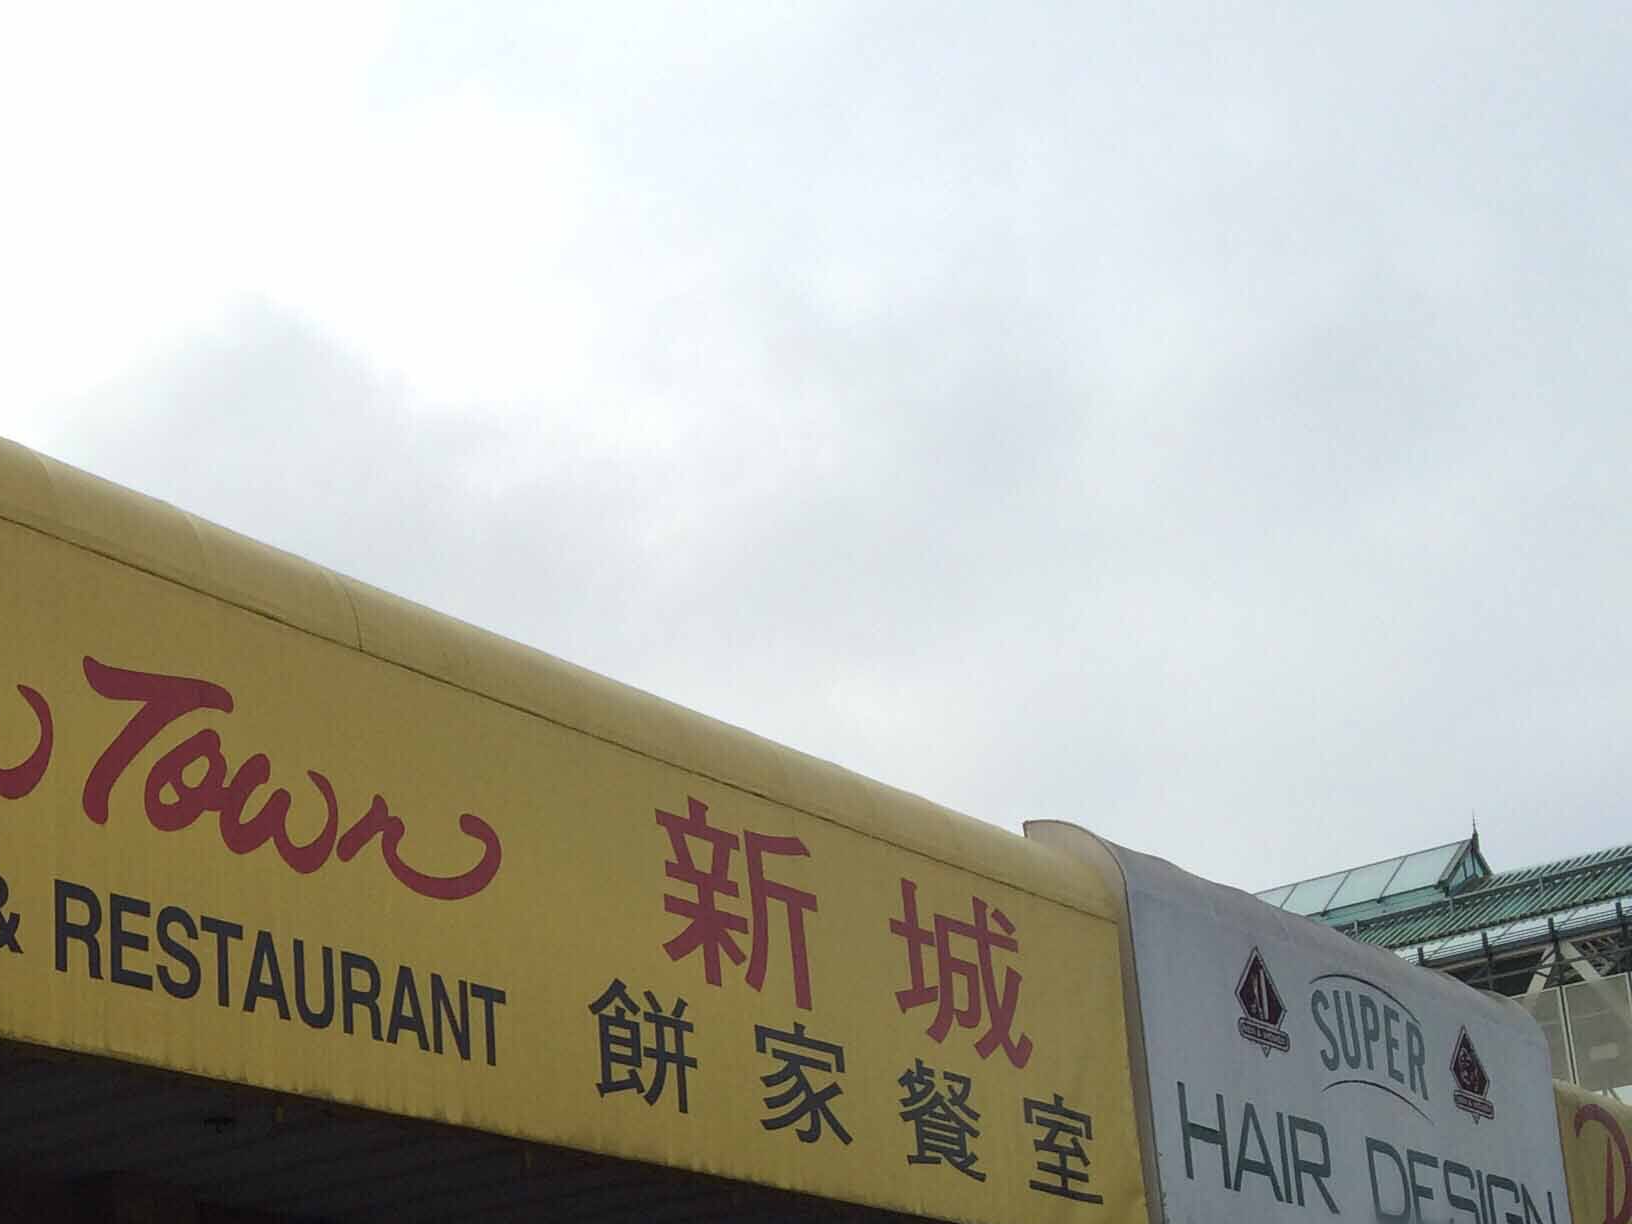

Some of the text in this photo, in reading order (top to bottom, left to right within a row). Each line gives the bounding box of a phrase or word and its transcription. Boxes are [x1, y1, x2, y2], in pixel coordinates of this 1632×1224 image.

[81, 655, 502, 900] Town
[53, 879, 507, 1067] RESTAURANT
[1310, 988, 1431, 1102] SUPER
[1176, 1081, 1341, 1216] HAIR
